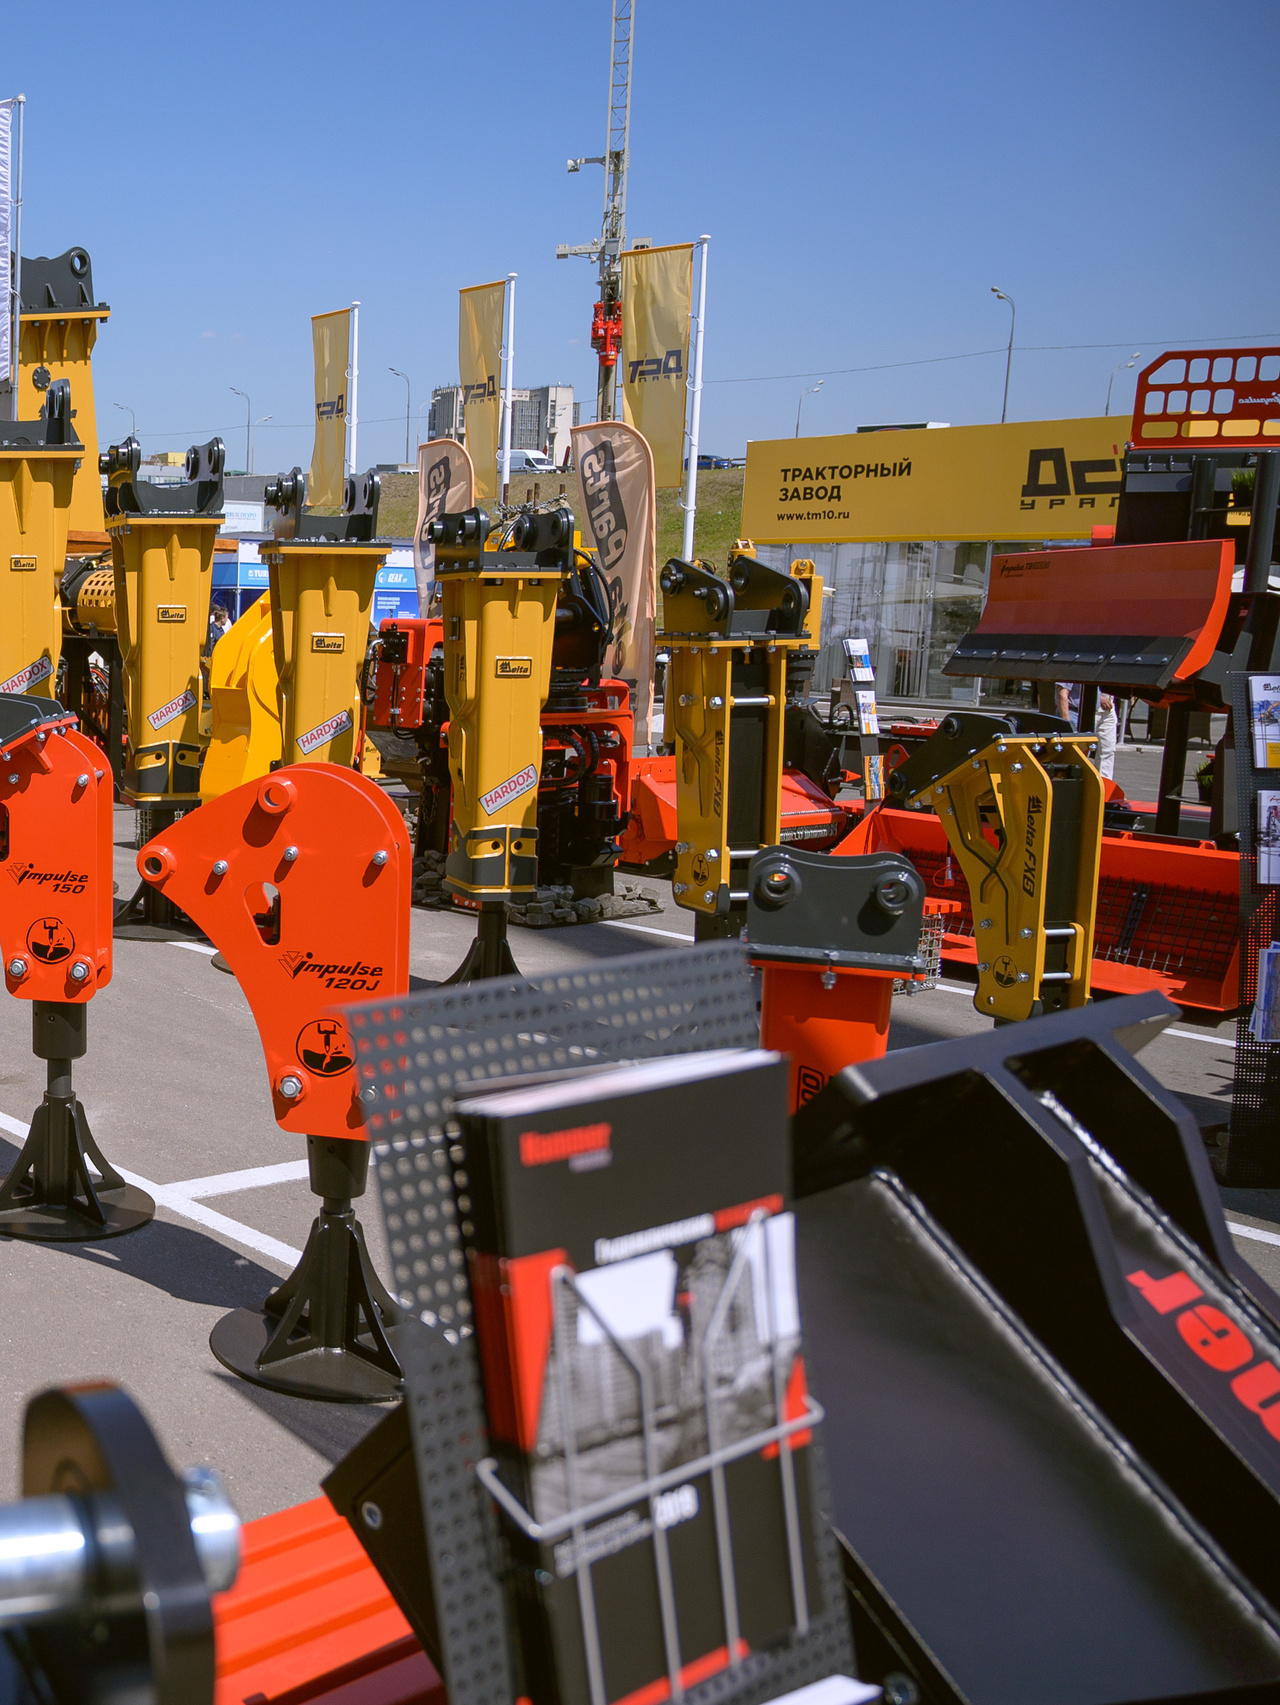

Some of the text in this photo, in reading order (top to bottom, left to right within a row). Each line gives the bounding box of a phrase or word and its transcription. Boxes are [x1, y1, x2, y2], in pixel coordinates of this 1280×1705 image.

[780, 457, 912, 482] ТРАКТОРНЫЙ
[778, 485, 842, 502] ЗАВОД
[777, 509, 850, 521] www.tm10.ru
[1, 660, 47, 693] HARDOX
[152, 693, 191, 724] HARDOX
[301, 714, 346, 747] HARDOX
[484, 769, 533, 808] HARDOX
[52, 883, 85, 894] 150
[325, 977, 380, 991] 120J
